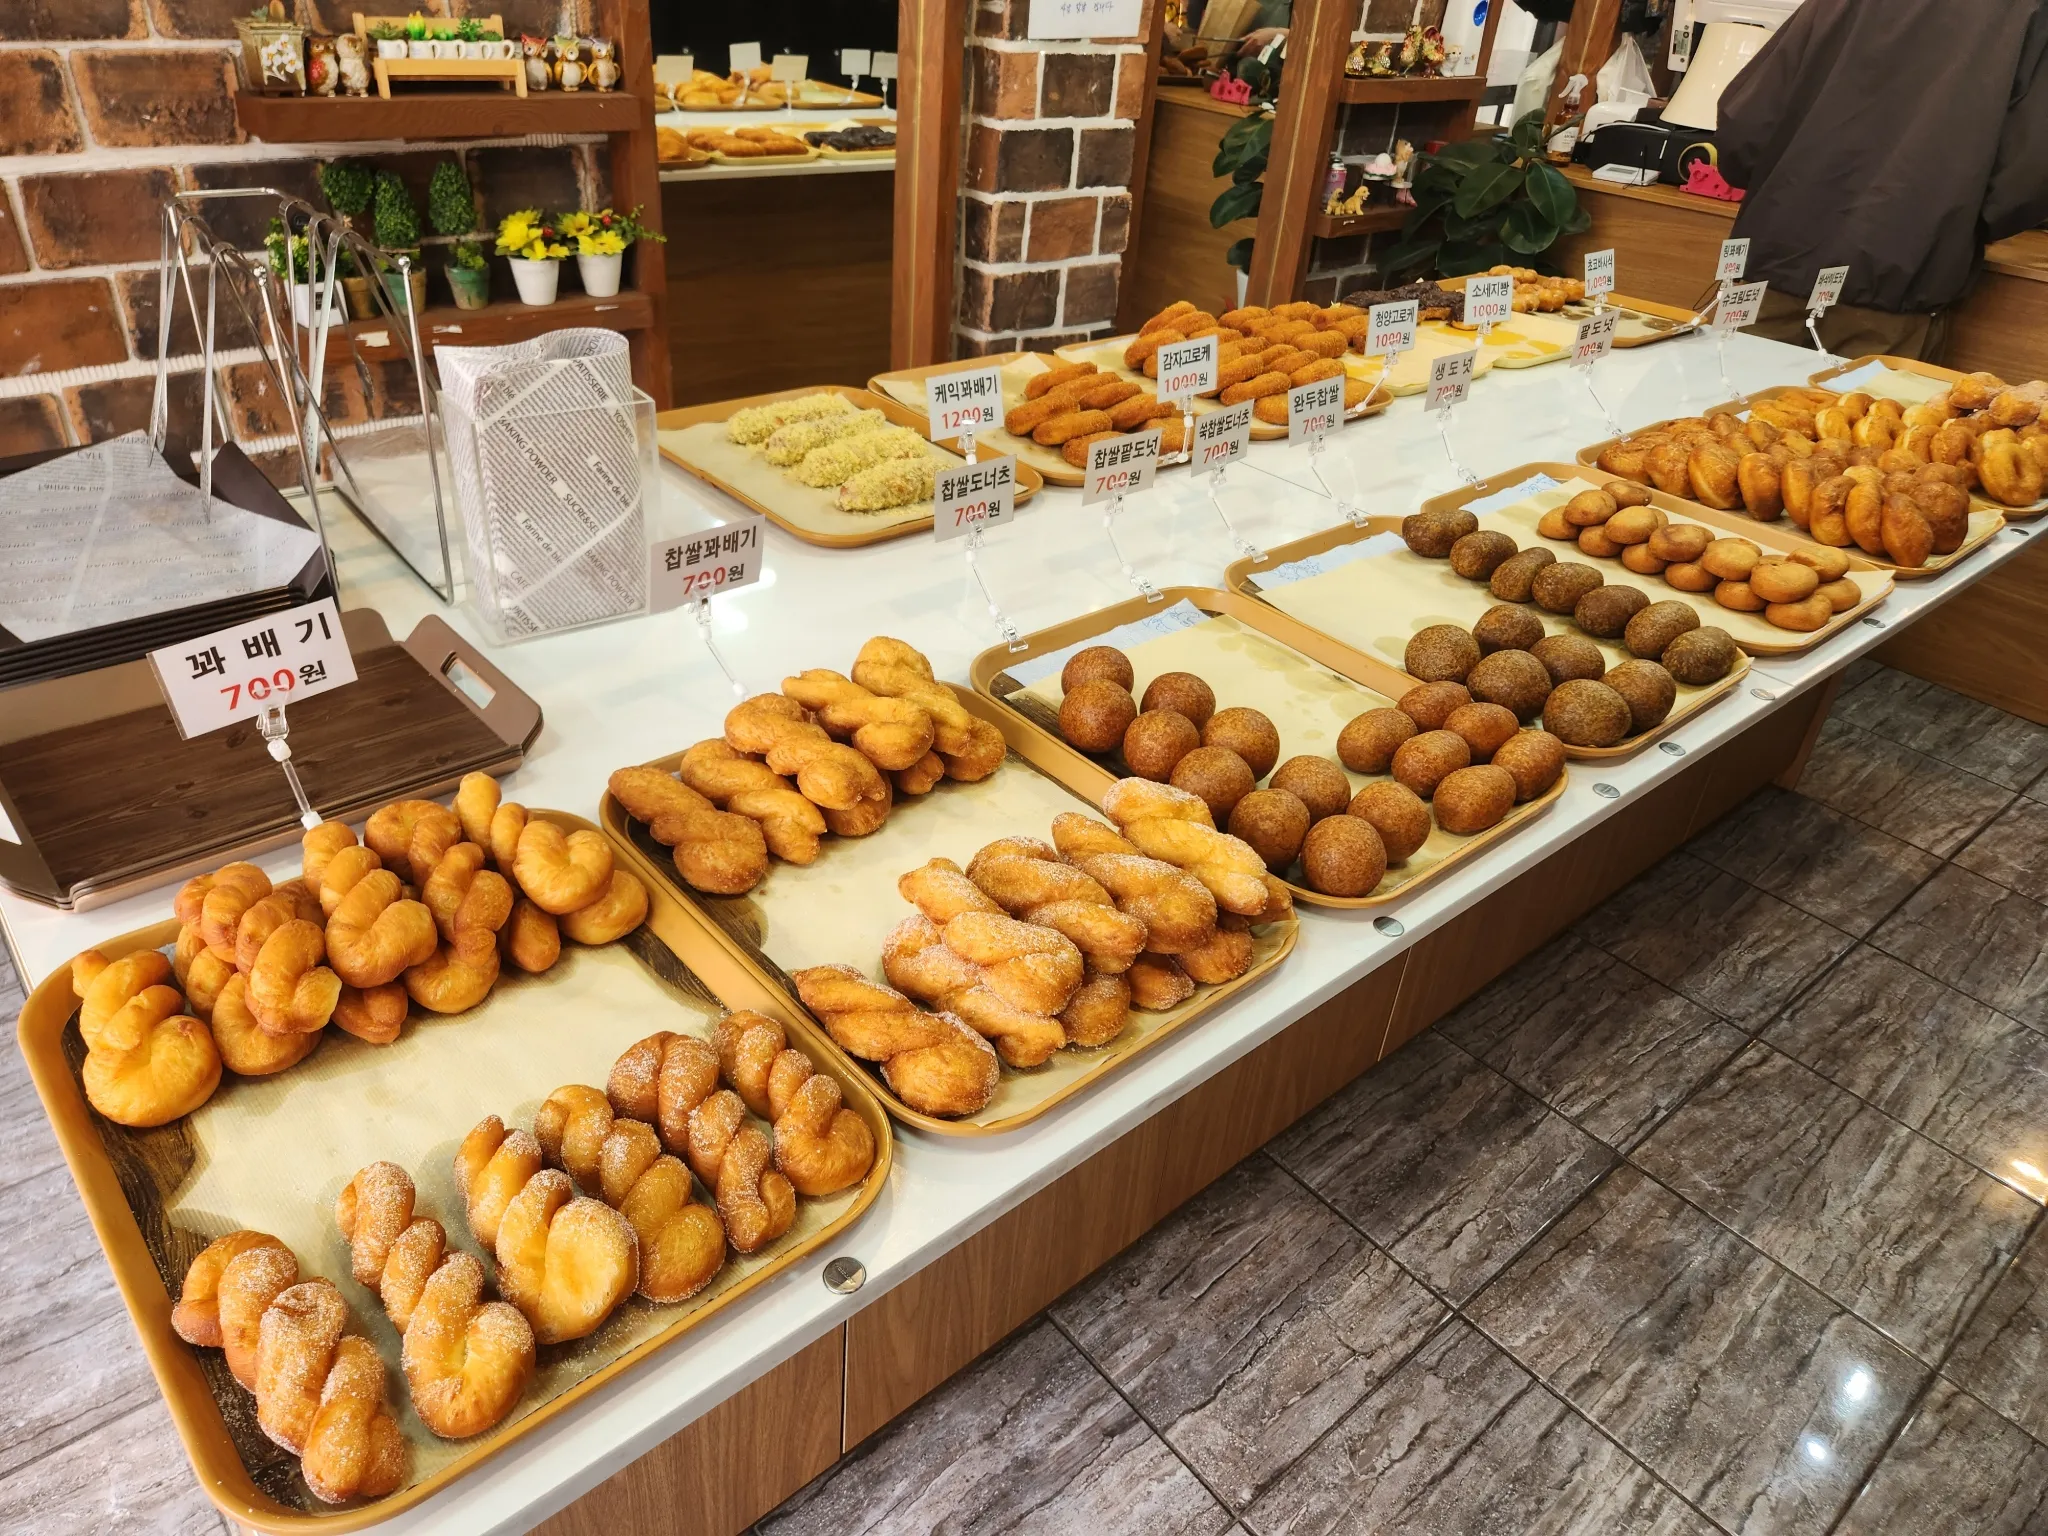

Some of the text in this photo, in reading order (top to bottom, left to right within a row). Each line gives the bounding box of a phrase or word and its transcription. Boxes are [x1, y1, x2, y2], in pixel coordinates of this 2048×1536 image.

[1471, 281, 1510, 298] 소세지빵
[1722, 287, 1761, 307] 슈크림도넛
[1375, 306, 1415, 328] 청양고로케
[1472, 303, 1507, 318] 1000원
[1375, 331, 1411, 348] 1000원
[1577, 341, 1605, 360] 700원
[1163, 343, 1211, 372] 감자고로케
[934, 374, 998, 404] 케익꽈배기
[1164, 372, 1208, 393] 1000원
[1435, 384, 1464, 402] 700원
[1293, 383, 1340, 414] 완두찹쌀
[941, 406, 995, 430] 1200원
[1199, 408, 1250, 441] 쑥찹쌀도너츠
[1303, 413, 1335, 435] 700원
[1094, 436, 1159, 471] 찹쌀팥도넛
[1203, 439, 1240, 464] 700원
[593, 460, 613, 486] Farine
[941, 464, 1011, 503] 찹쌀도너츠
[1095, 469, 1142, 495] 700원
[526, 444, 558, 485] POWDER
[563, 493, 600, 535] SUCRE&SEL
[954, 499, 1001, 527] 700원
[522, 517, 543, 545] Farine
[664, 525, 757, 572] 찹쌀꽈배기
[585, 549, 636, 606] BAKING POWDER
[682, 563, 745, 596] 700원
[219, 659, 328, 711] 700원
